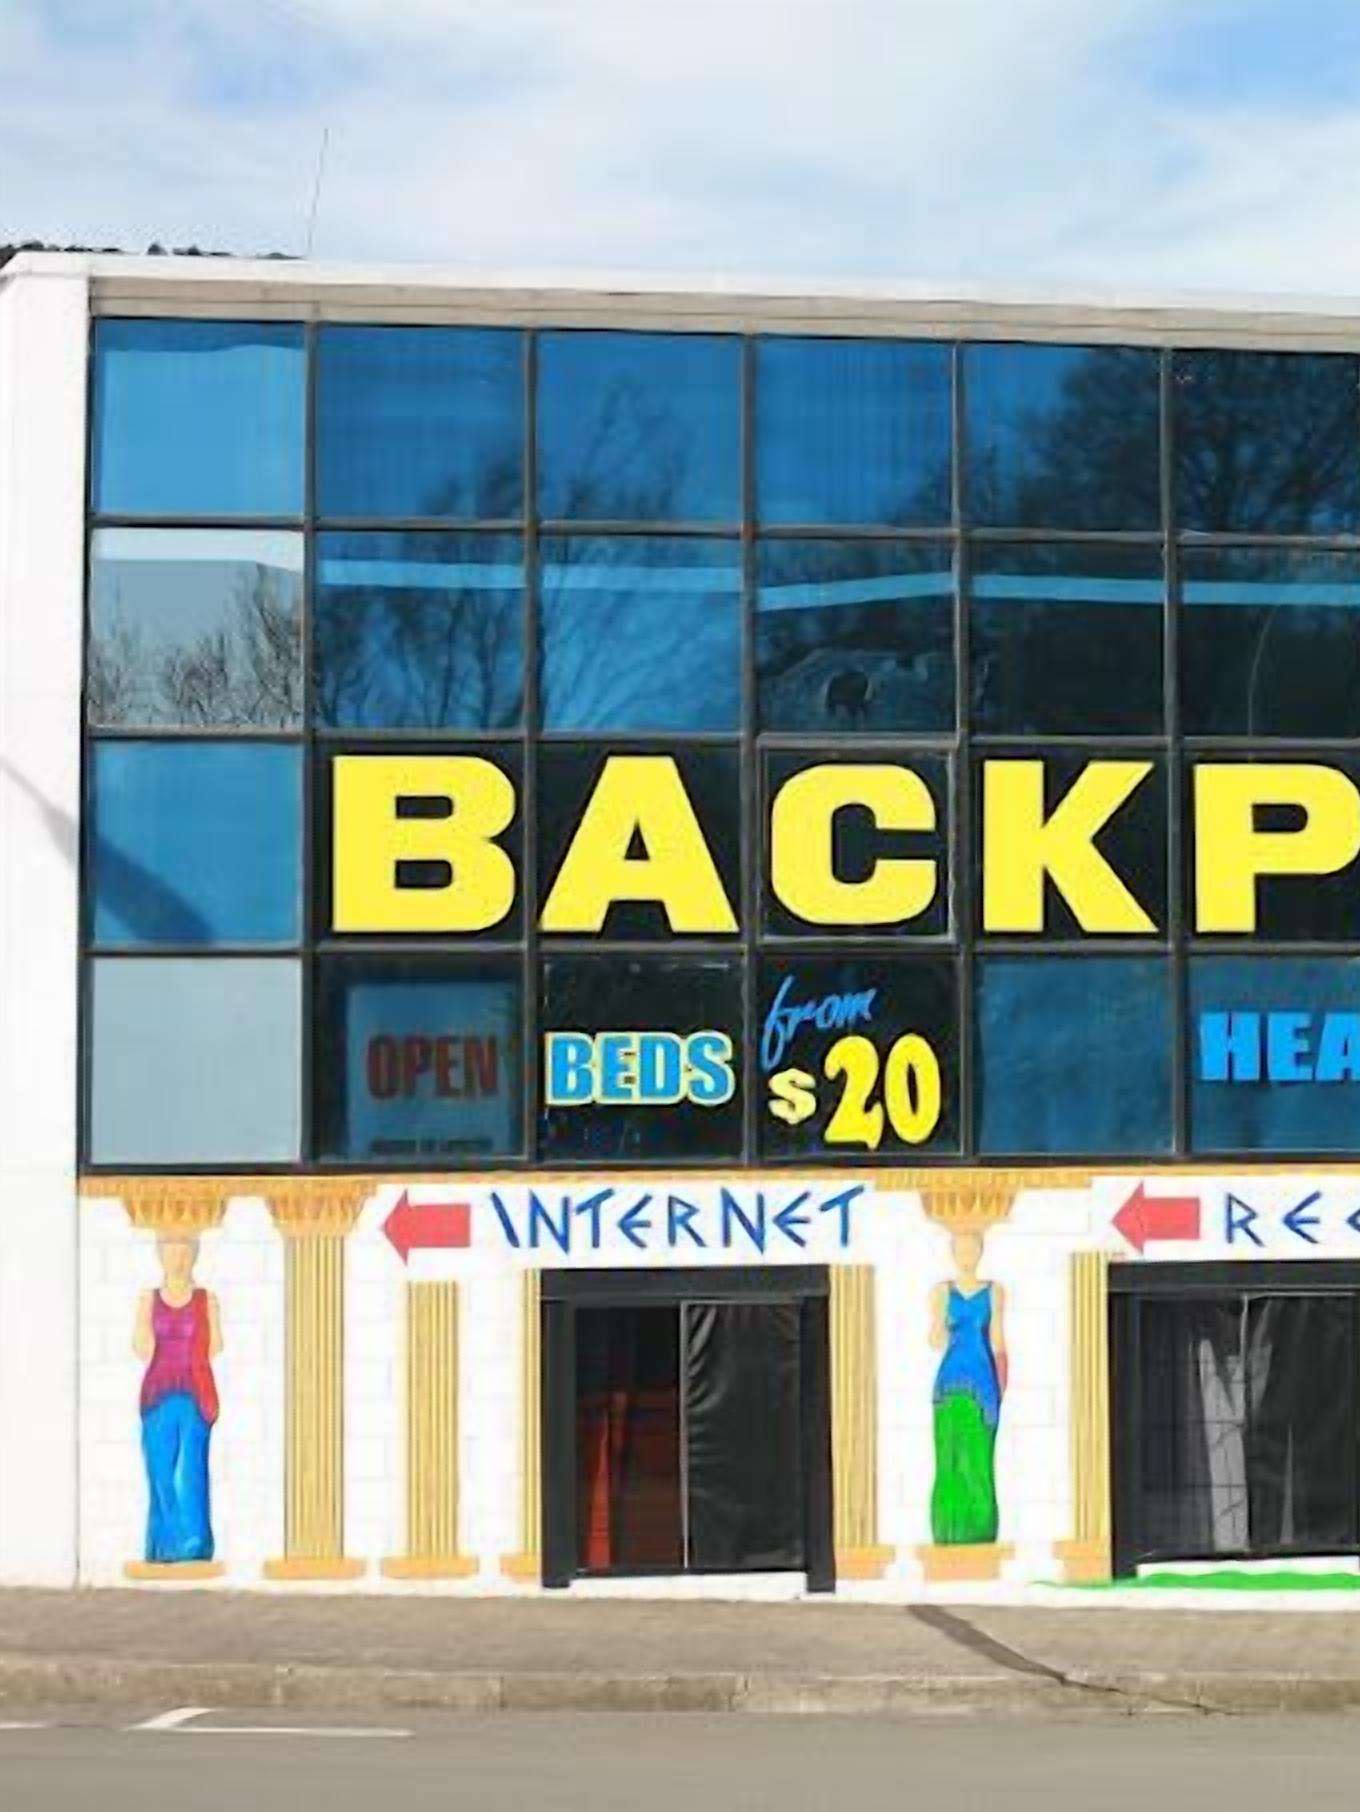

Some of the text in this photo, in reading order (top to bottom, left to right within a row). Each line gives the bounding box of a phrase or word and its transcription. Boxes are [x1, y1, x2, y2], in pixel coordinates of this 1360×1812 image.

[762, 974, 876, 1072] from
[366, 1034, 498, 1101] OPEN
[545, 1031, 735, 1106] BEDS
[768, 1033, 942, 1150] $20
[490, 1184, 866, 1255] INTERNET
